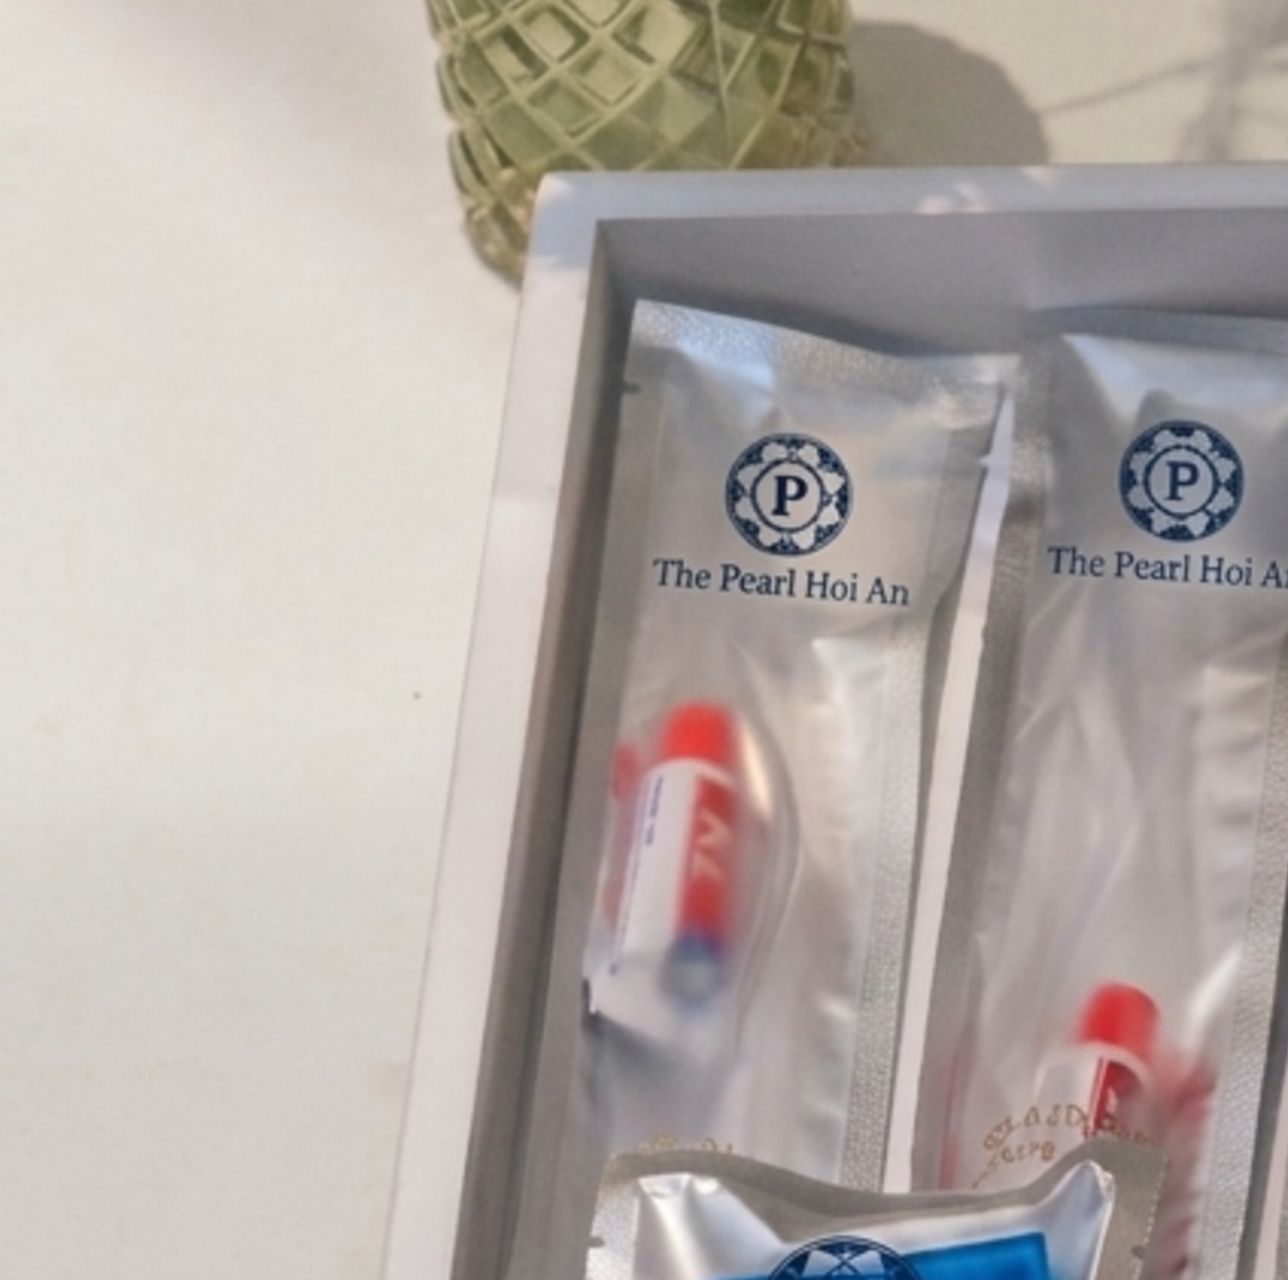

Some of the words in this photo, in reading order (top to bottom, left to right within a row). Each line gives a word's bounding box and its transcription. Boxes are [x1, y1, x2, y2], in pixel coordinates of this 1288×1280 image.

[772, 475, 808, 517] P
[1168, 461, 1199, 501] P
[653, 558, 711, 590] The
[719, 563, 796, 597] Pearl
[805, 570, 858, 602] Hoi
[865, 576, 910, 607] An
[1047, 546, 1105, 578] The
[1114, 551, 1190, 583] Pearl
[1200, 554, 1252, 587] Hoi
